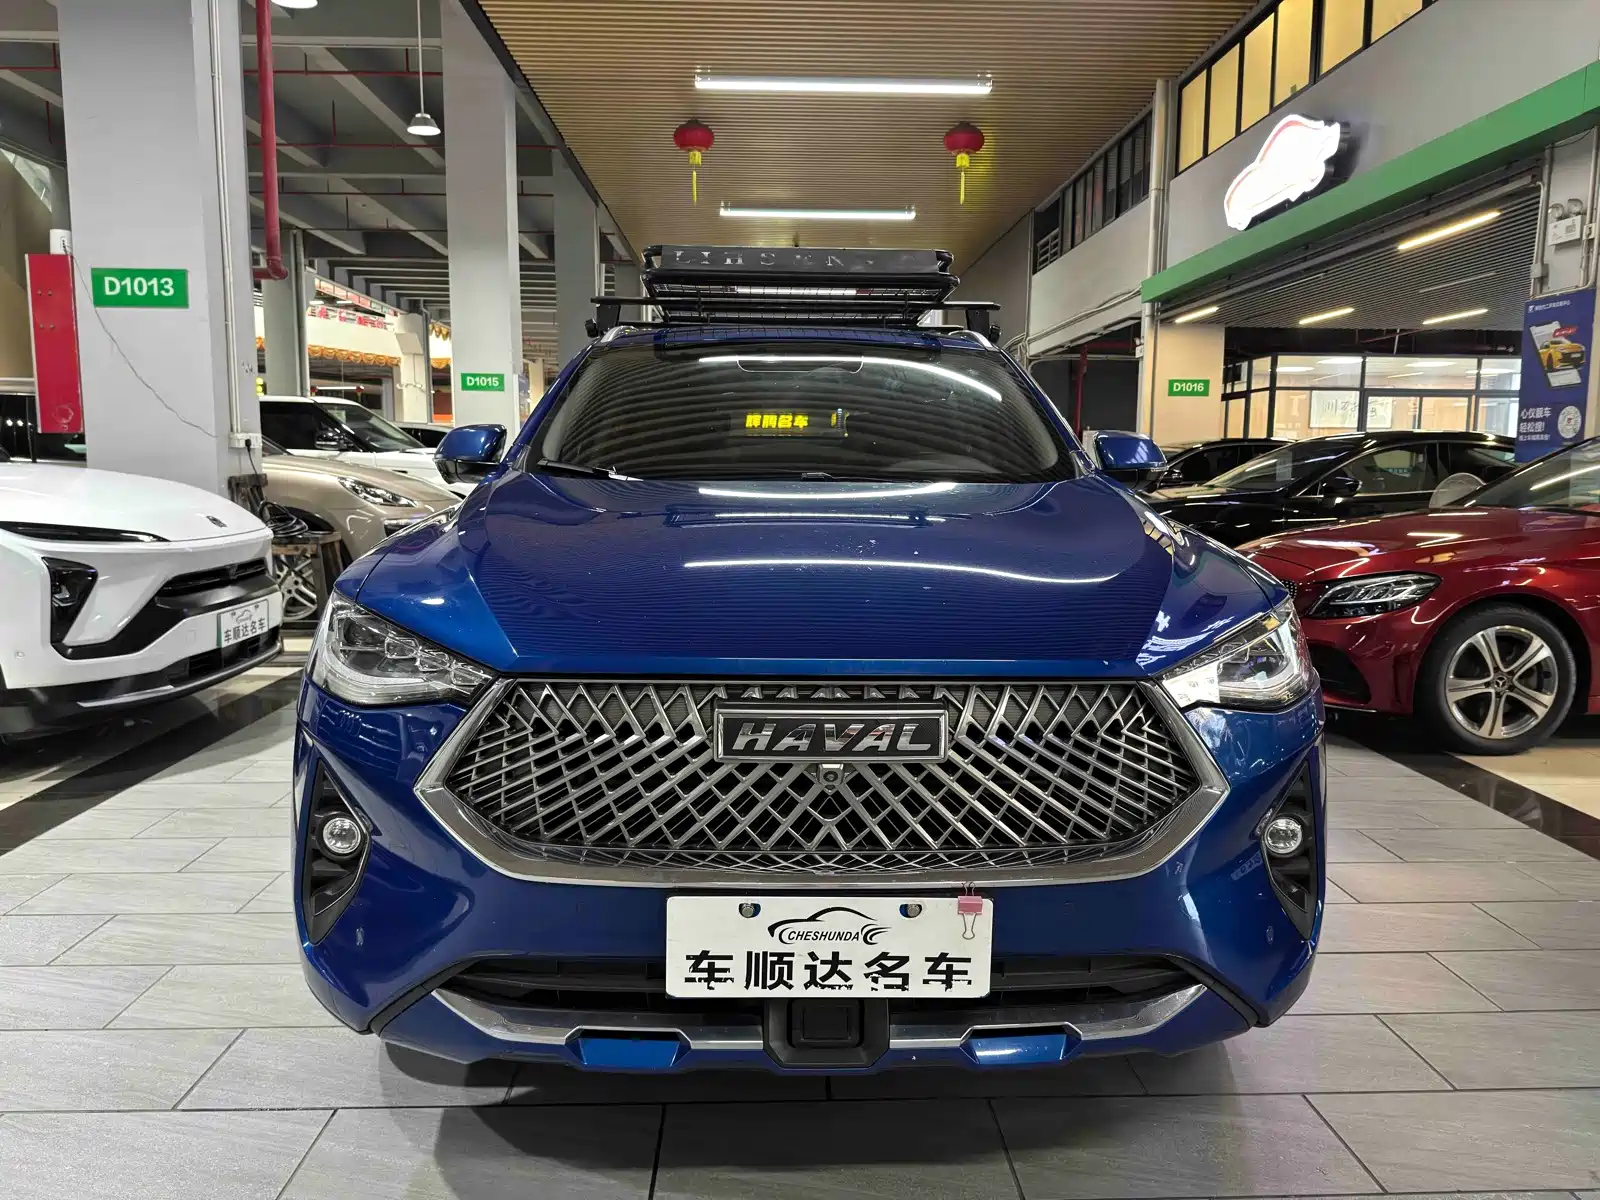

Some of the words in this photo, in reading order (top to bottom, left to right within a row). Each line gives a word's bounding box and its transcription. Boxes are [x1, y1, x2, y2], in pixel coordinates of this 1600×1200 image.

[104, 276, 175, 297] D1013
[466, 375, 500, 387] D1015
[1173, 382, 1205, 392] D1016
[732, 722, 932, 752] HAVAL
[787, 929, 861, 943] CHESHUNDA
[683, 949, 973, 993] 车顺达名车
